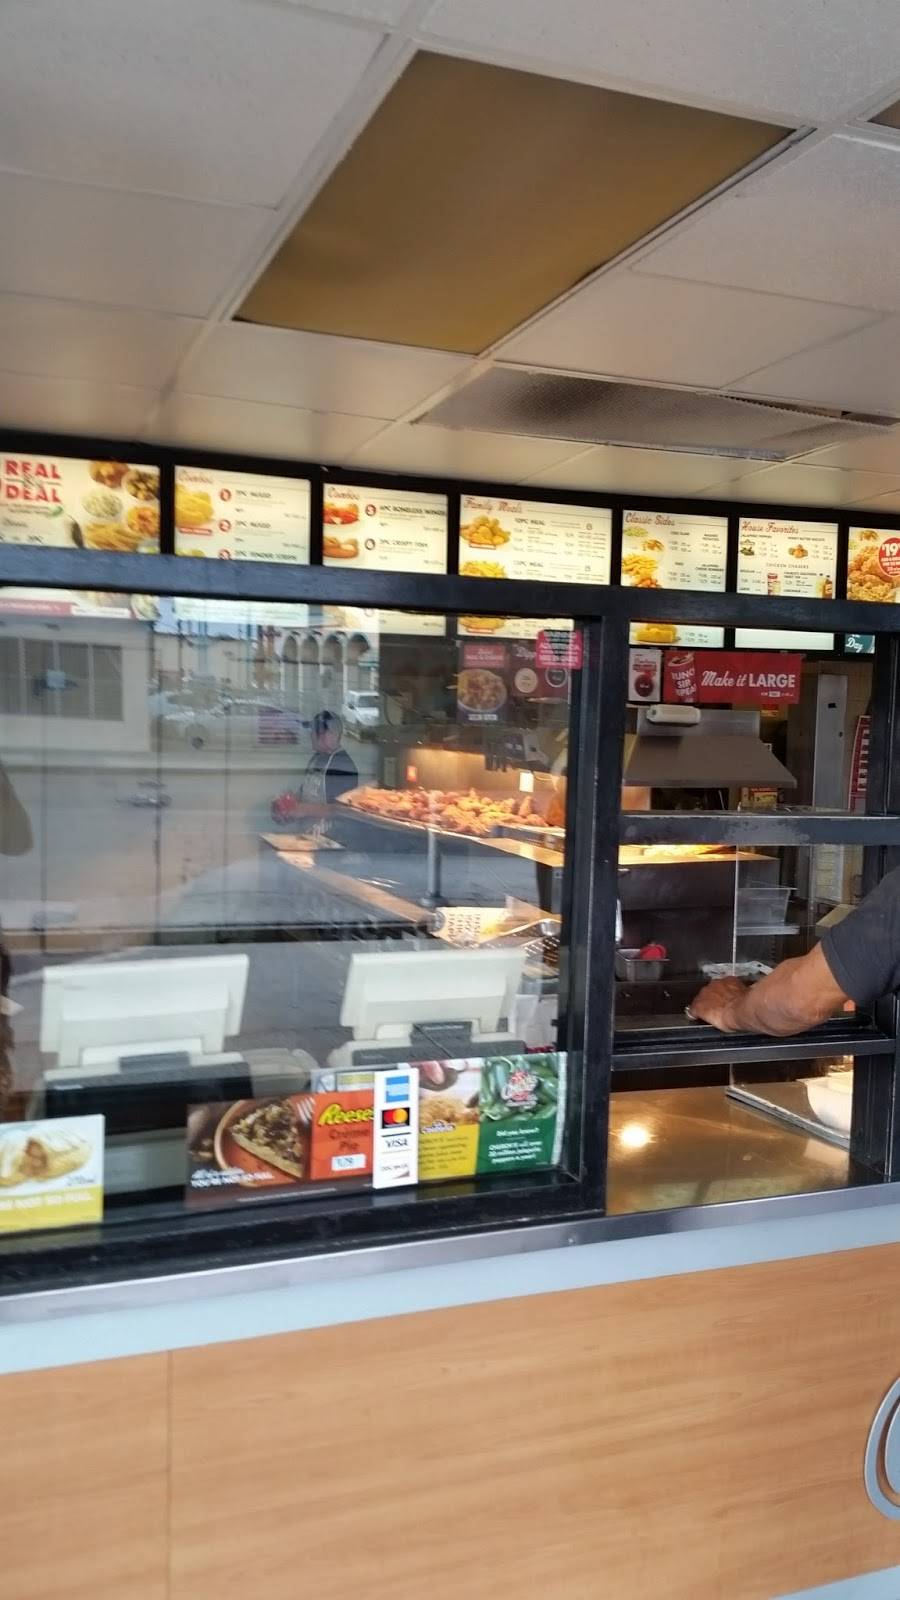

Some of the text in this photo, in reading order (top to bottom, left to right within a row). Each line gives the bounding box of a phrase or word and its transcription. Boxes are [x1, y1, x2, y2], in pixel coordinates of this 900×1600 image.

[5, 460, 62, 479] REAL
[6, 485, 62, 503] DEAL
[625, 512, 676, 526] Classic Sides
[742, 520, 800, 535] House Favorites
[846, 637, 864, 653] Day
[701, 671, 796, 688] Make it LARGE
[339, 1141, 360, 1152] Pie
[386, 1137, 409, 1148] VISA
